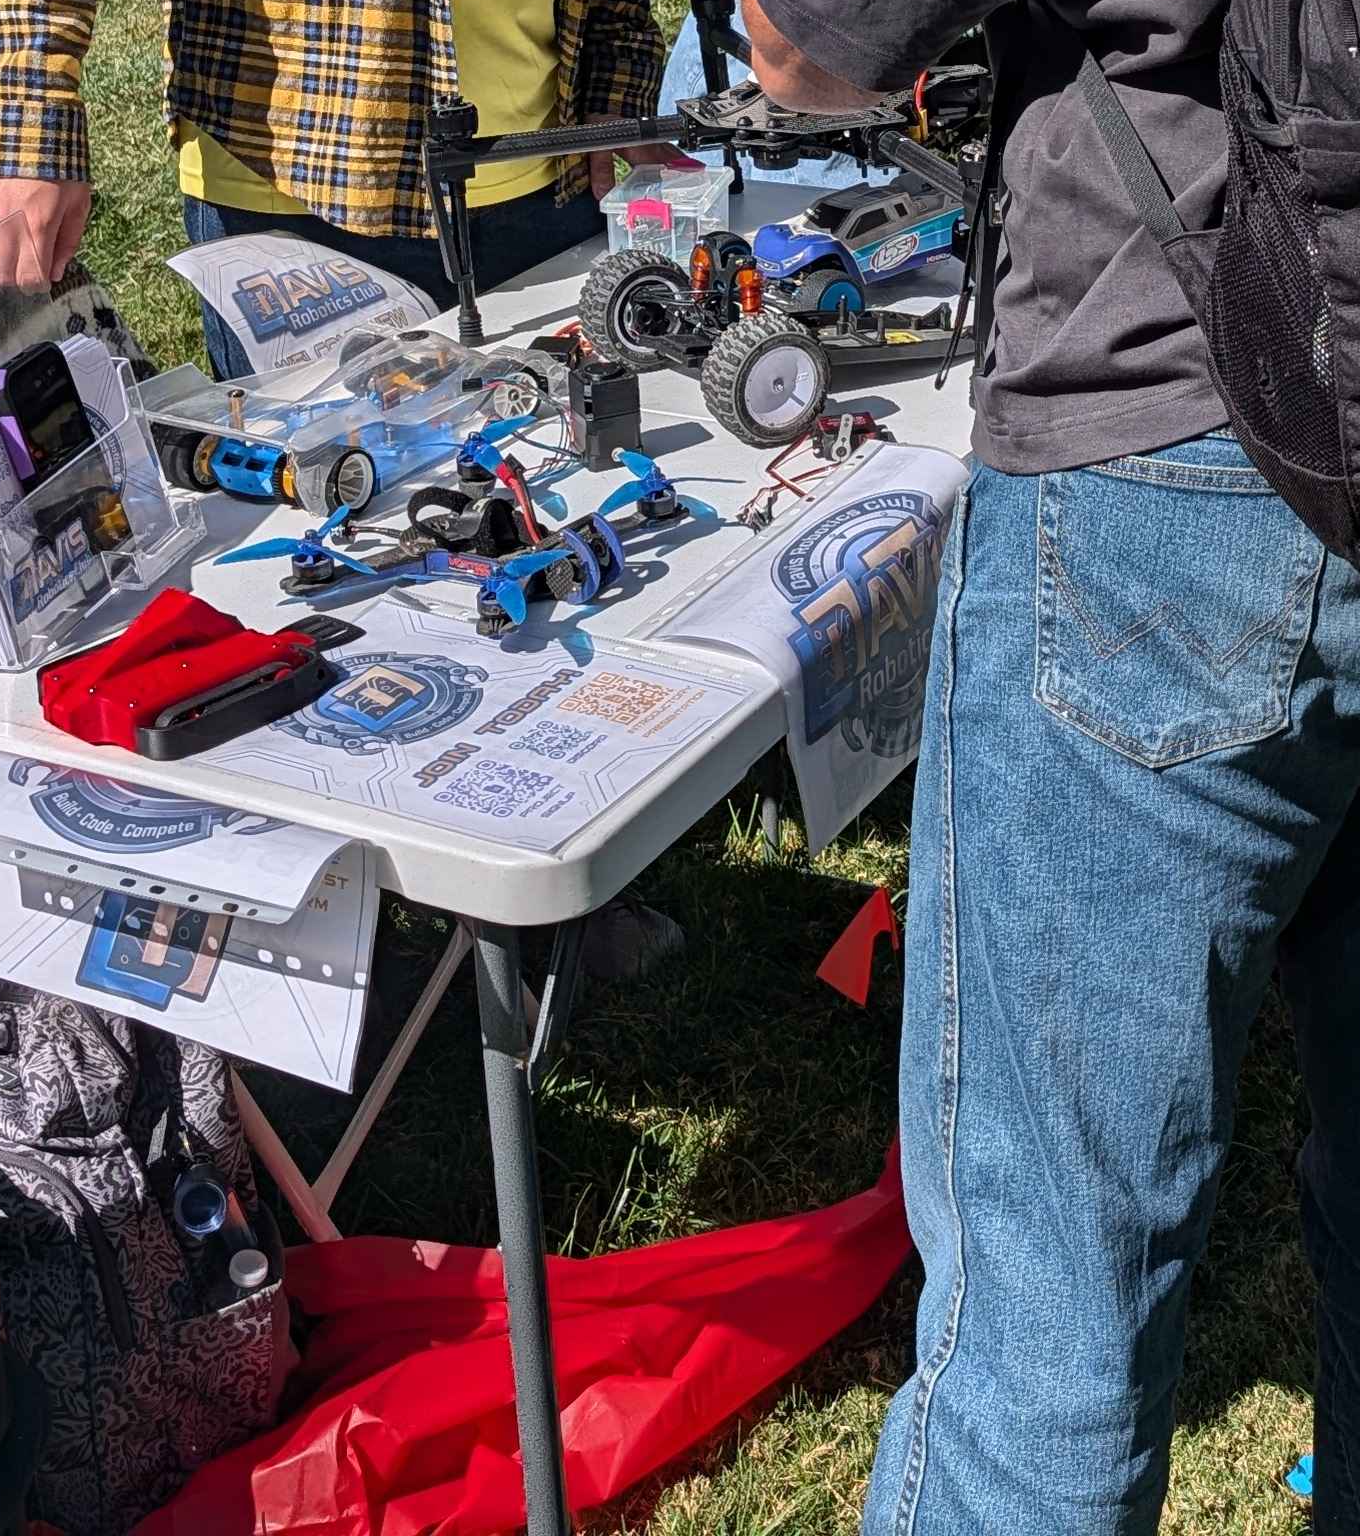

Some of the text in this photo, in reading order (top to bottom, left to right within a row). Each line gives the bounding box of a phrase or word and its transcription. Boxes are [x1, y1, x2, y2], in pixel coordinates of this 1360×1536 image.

[289, 282, 382, 332] Robotics Club
[784, 494, 917, 591] Davis Robotics Club
[341, 655, 382, 667] Club
[858, 625, 934, 710] Robotic
[413, 667, 585, 789] JOIN TODAY!
[51, 791, 195, 840] Build Code Compete
